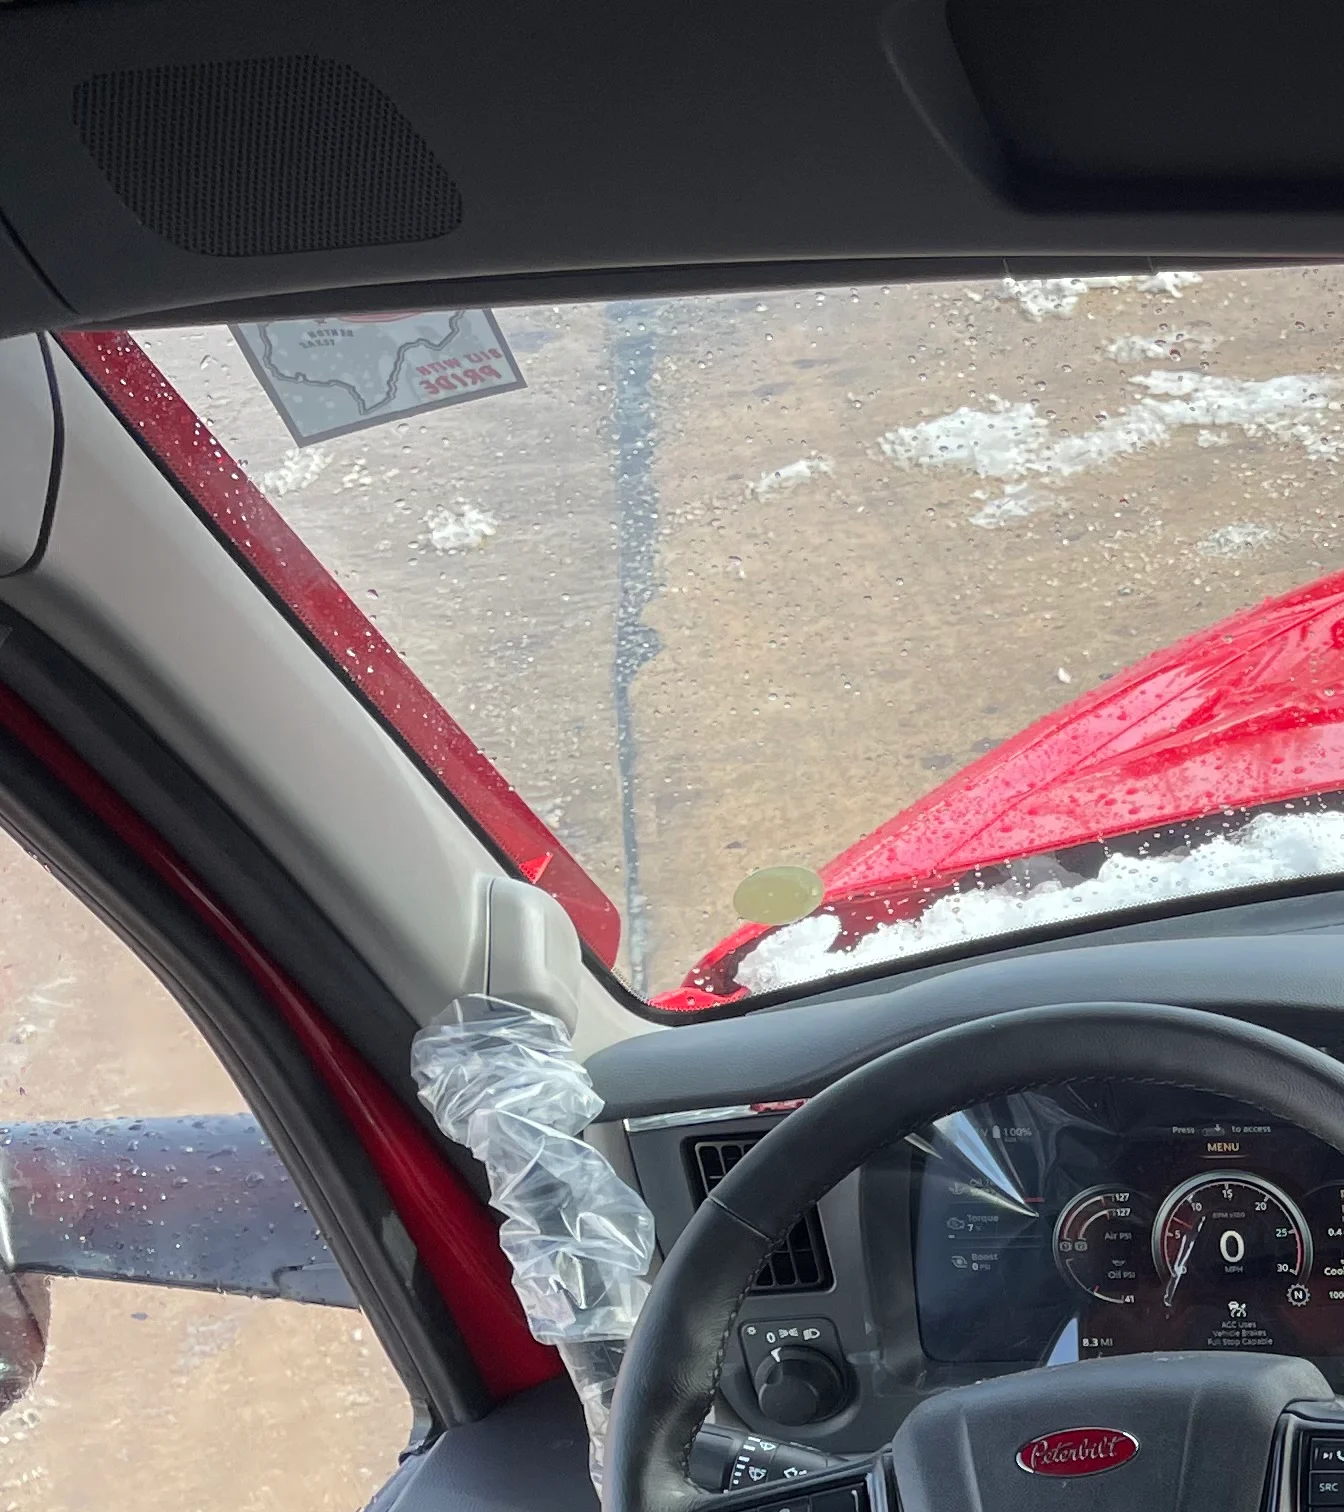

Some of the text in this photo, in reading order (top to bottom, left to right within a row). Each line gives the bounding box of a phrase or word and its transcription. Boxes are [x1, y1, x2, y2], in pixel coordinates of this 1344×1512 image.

[1172, 1125, 1271, 1134] Press to access
[1207, 1143, 1239, 1151] MENU
[1115, 1193, 1130, 1202] 127
[1222, 1189, 1233, 1199] 15
[1191, 1202, 1202, 1211] 10
[1255, 1202, 1267, 1211] 20
[1116, 1208, 1131, 1217] 127
[967, 1214, 998, 1224] Torque
[1276, 1228, 1287, 1237] 25
[1328, 1228, 1342, 1236] 0.4
[1220, 1230, 1244, 1263] 0
[971, 1253, 998, 1261] Boost
[1277, 1264, 1288, 1272] 30
[1124, 1295, 1135, 1303] 41
[1294, 1291, 1302, 1299] N
[1082, 1338, 1098, 1347] 8.3
[1030, 1435, 1122, 1465] Peterbilt
[1318, 1480, 1339, 1493] SRC
